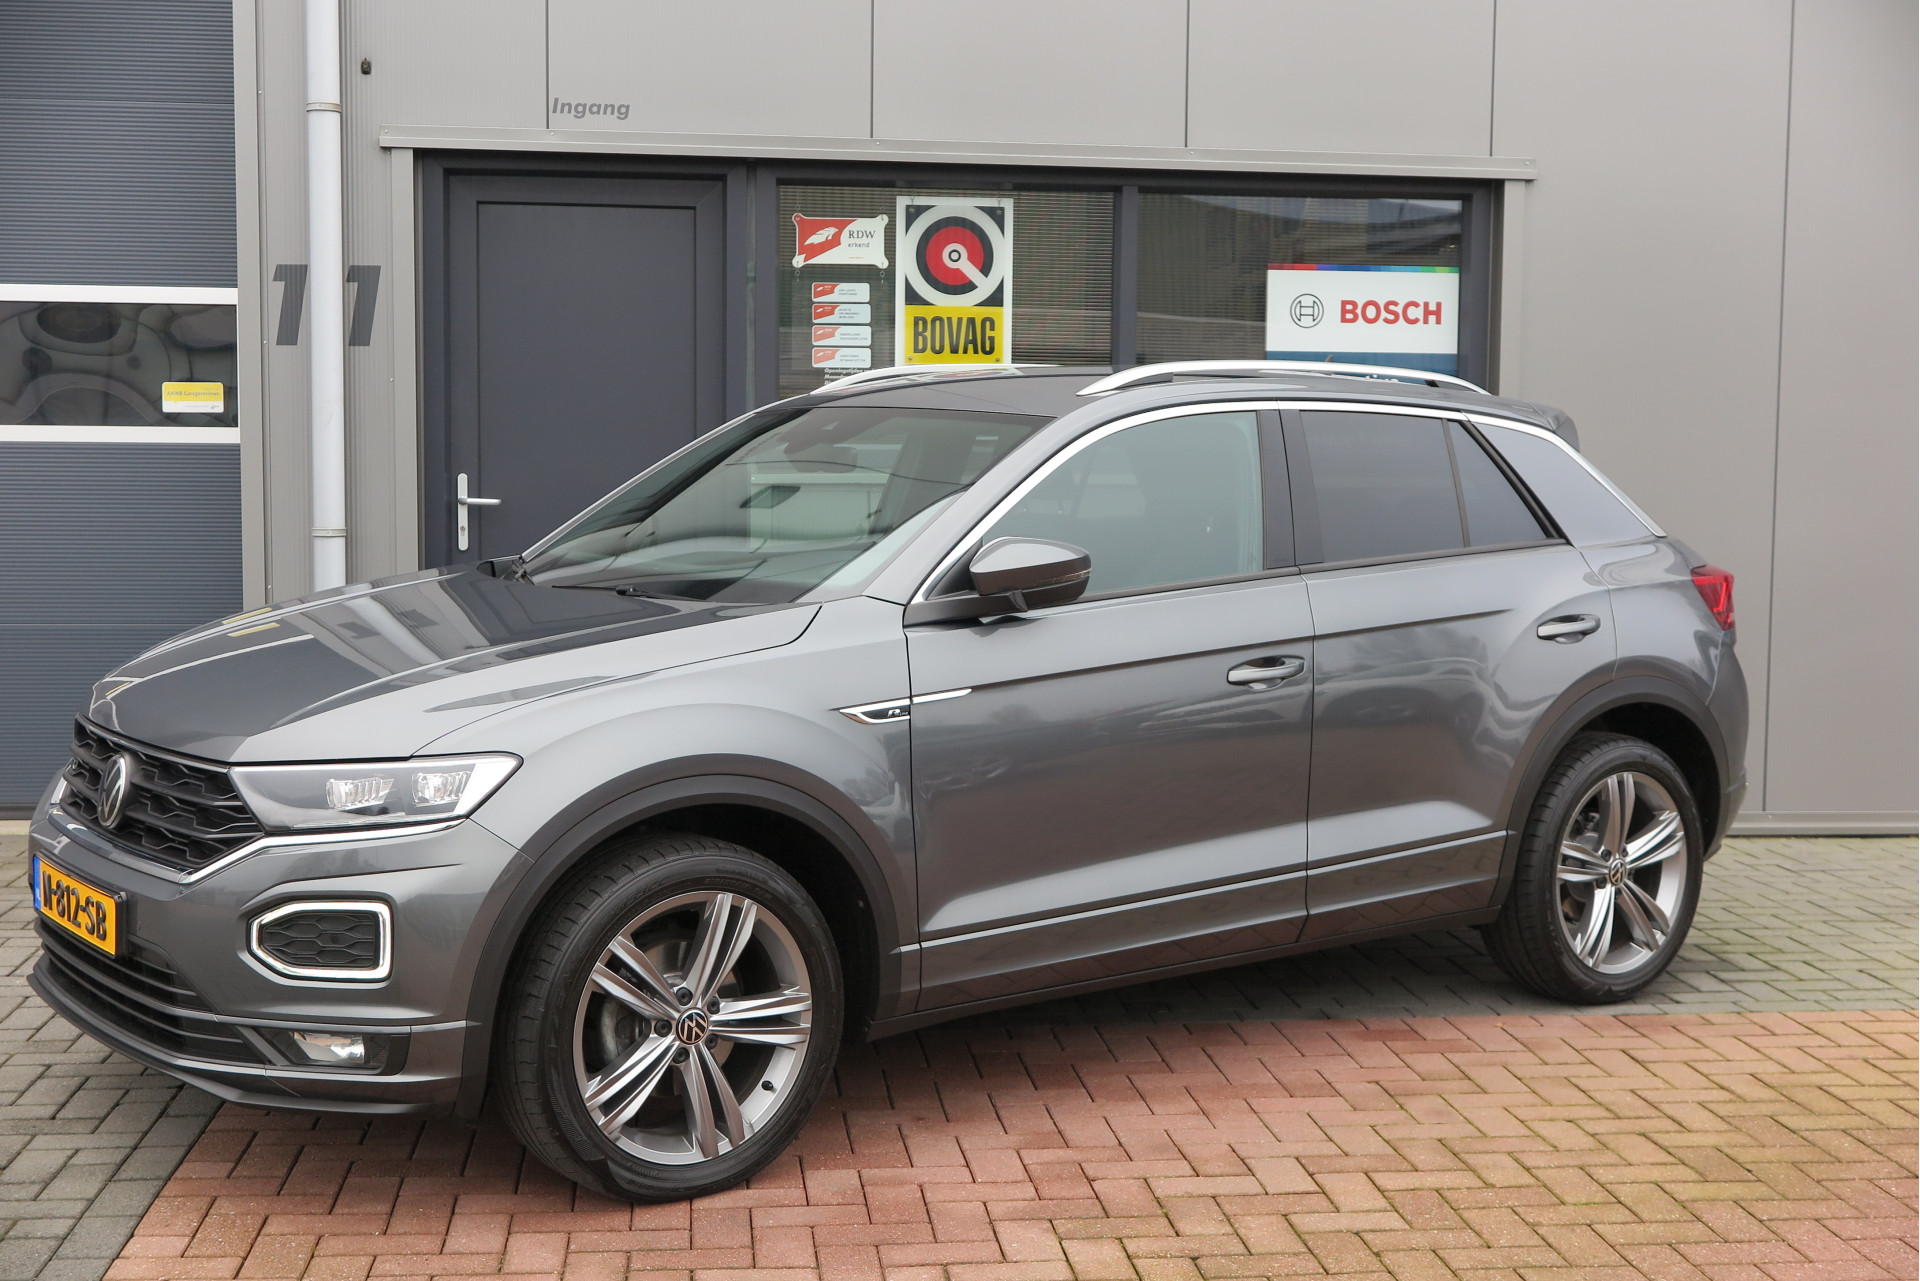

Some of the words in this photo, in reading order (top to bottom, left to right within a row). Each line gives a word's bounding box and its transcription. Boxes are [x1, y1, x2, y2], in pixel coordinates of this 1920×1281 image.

[552, 97, 630, 120] Ingang
[848, 230, 876, 239] RDW
[1340, 300, 1443, 325] BOSCH
[913, 315, 996, 356] BOVAG
